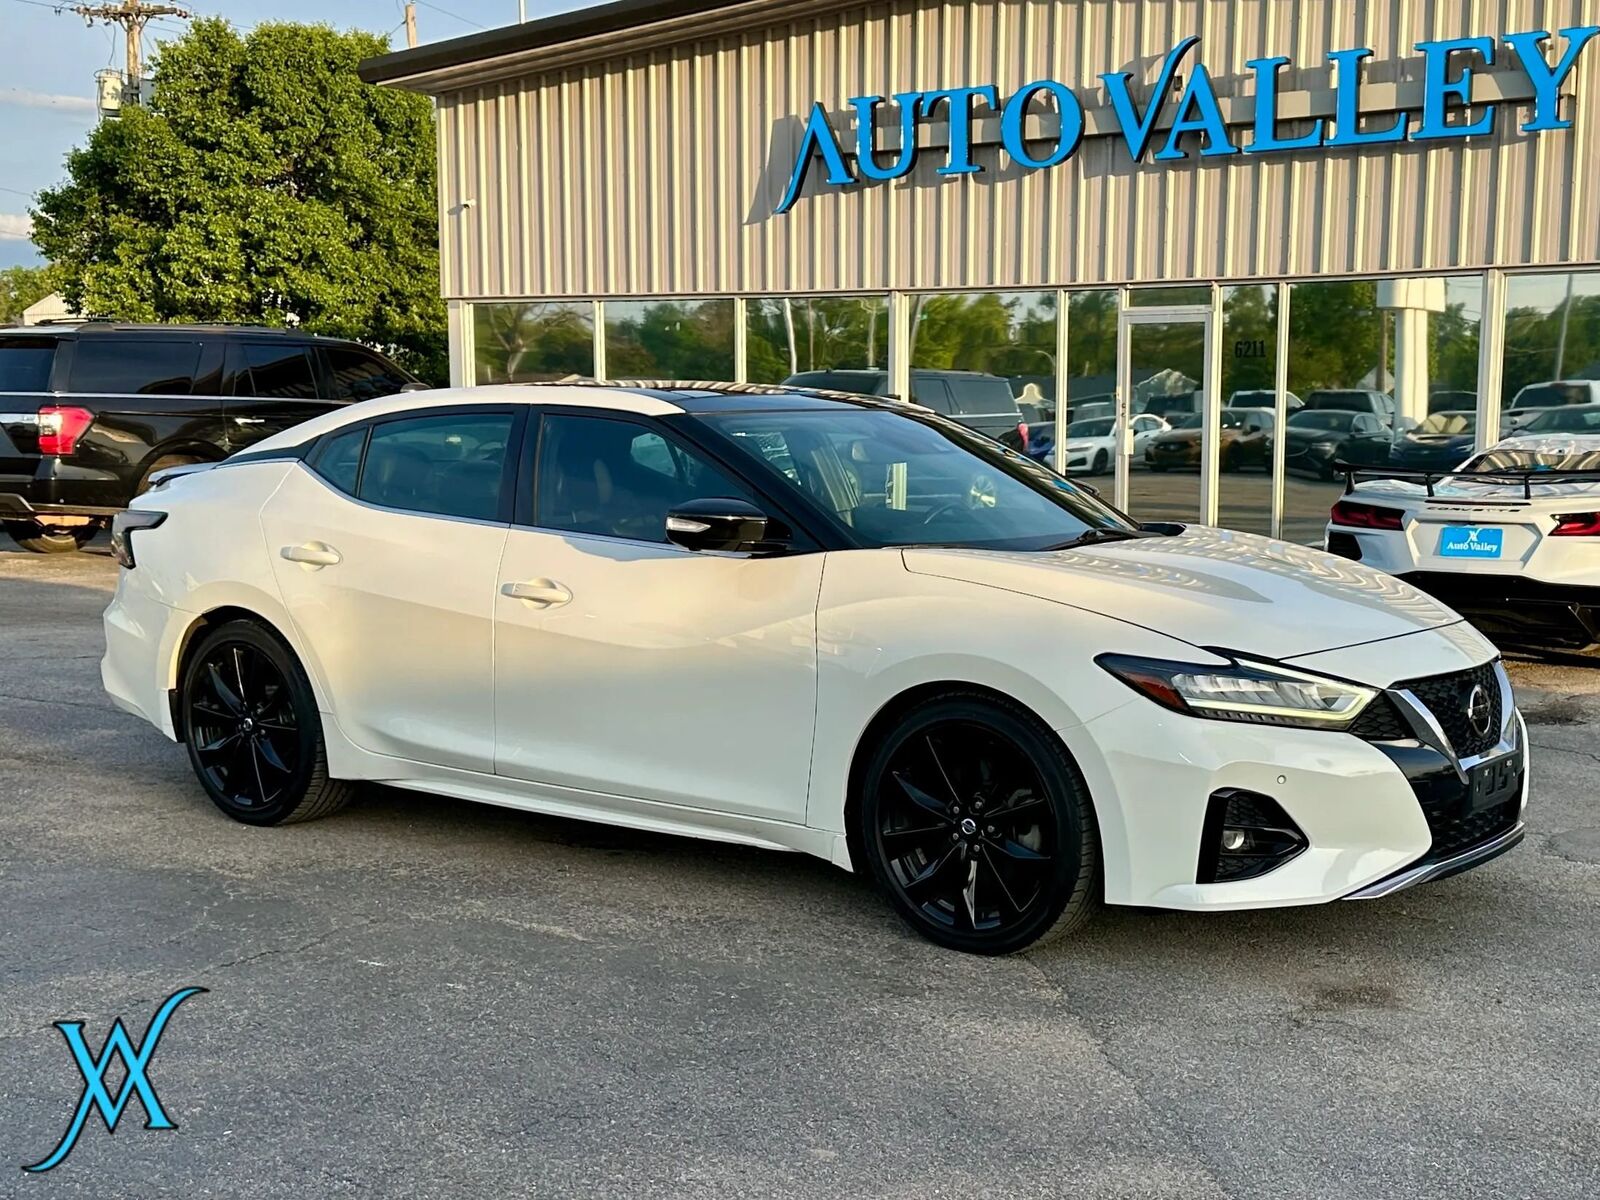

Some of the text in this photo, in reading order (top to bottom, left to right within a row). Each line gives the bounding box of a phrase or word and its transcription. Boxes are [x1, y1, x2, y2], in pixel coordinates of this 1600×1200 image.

[776, 25, 1600, 214] AUTO VALLEY
[1234, 340, 1266, 358] 6211
[1447, 542, 1498, 553] Auto Valley
